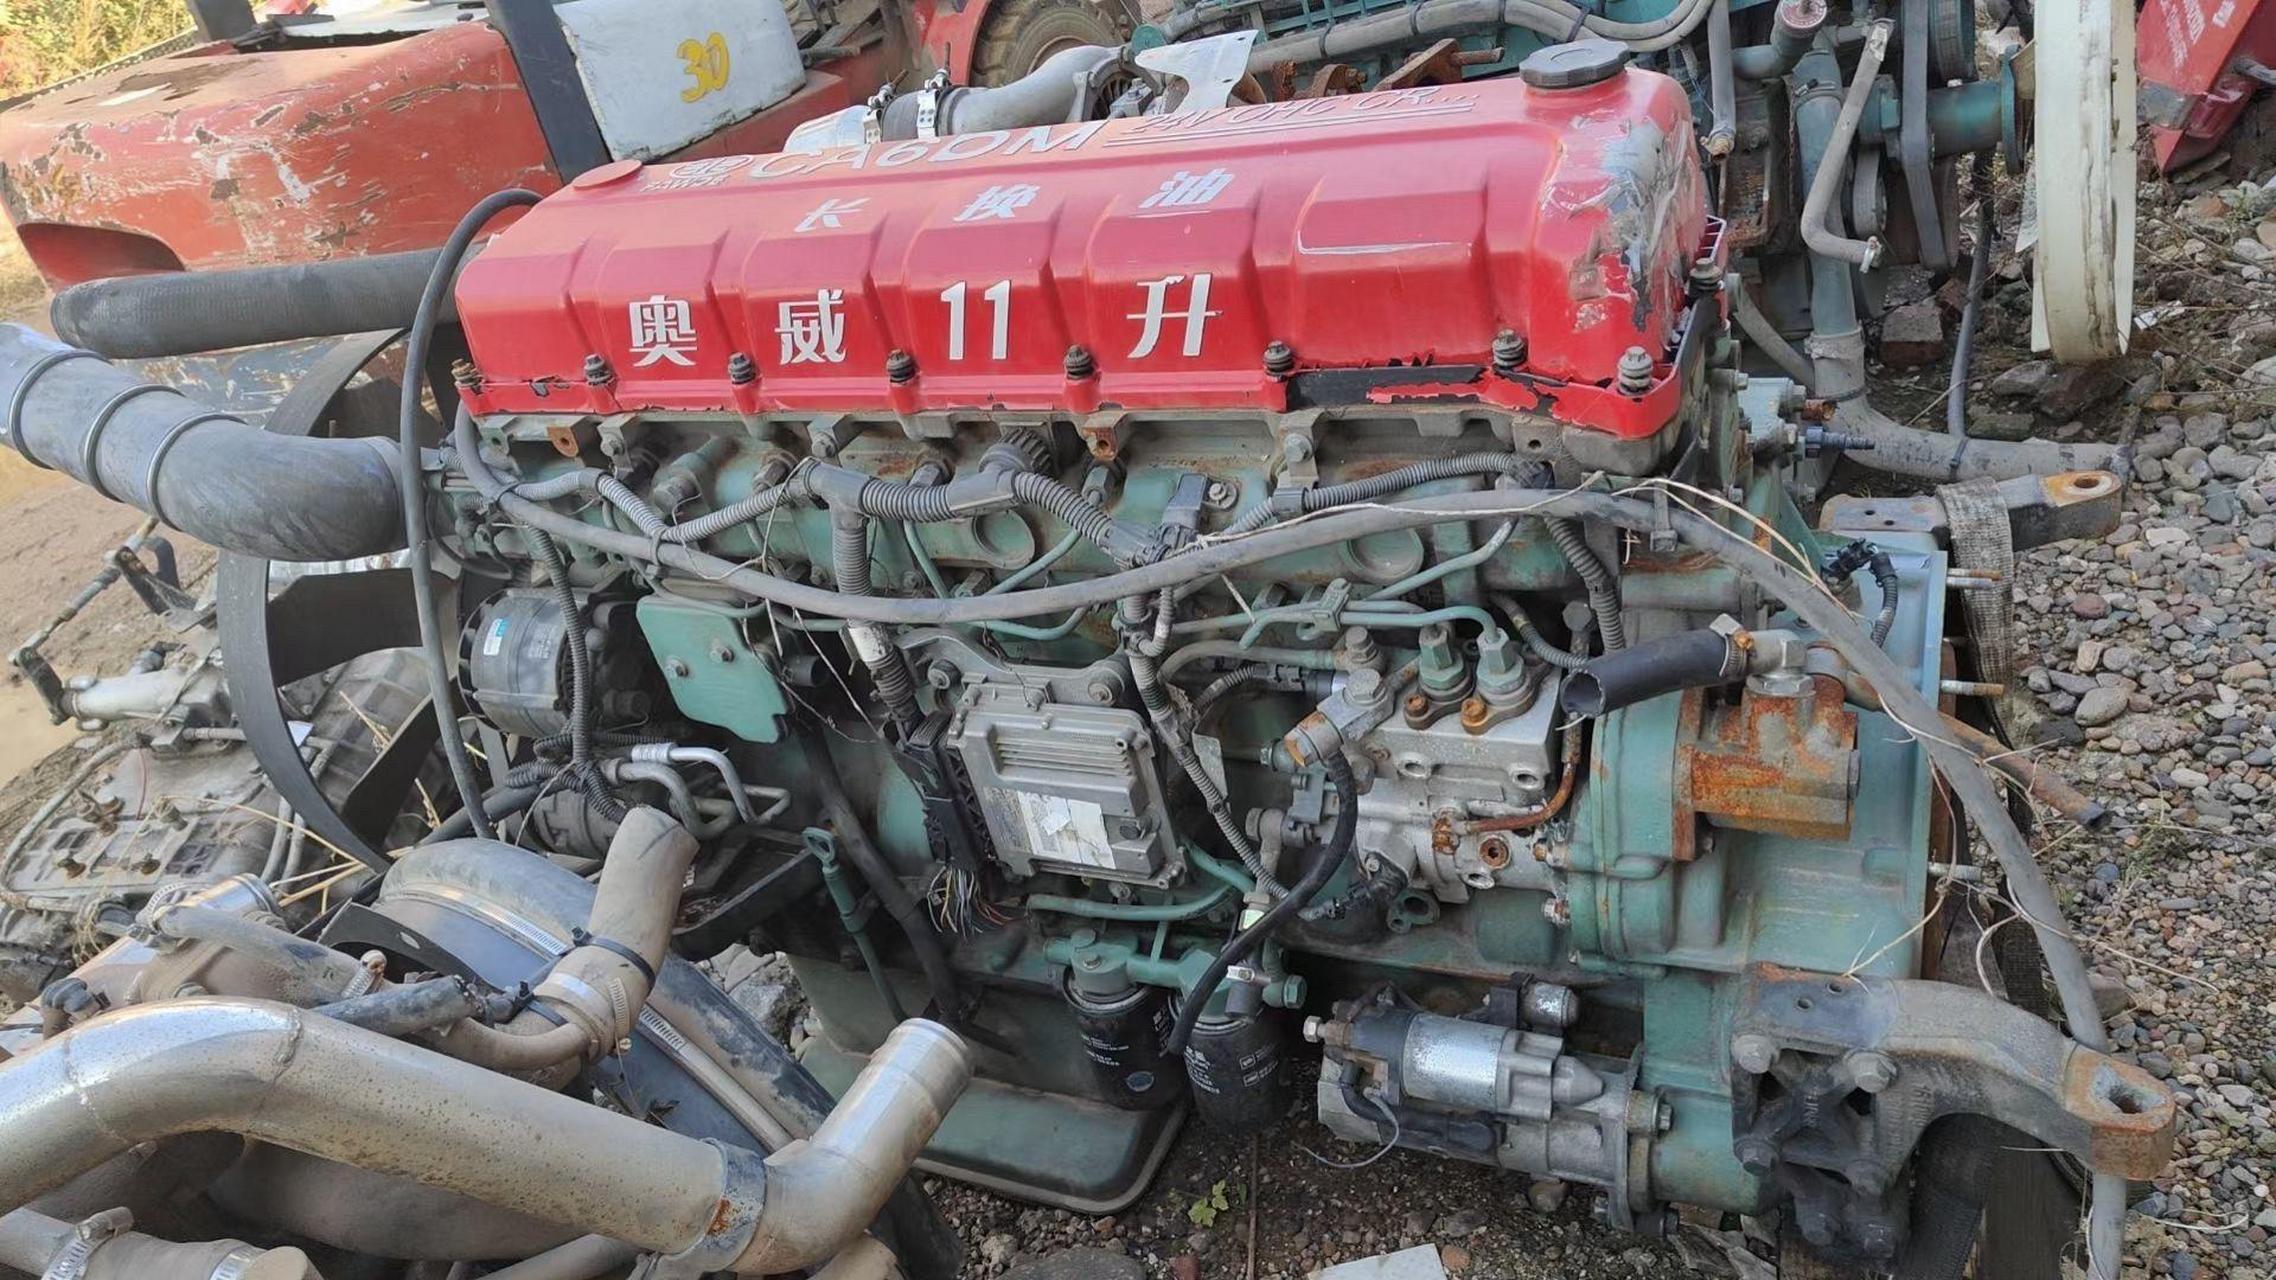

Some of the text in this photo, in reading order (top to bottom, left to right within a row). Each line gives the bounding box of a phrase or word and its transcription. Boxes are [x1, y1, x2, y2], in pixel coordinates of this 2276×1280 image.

[677, 32, 729, 103] 30
[750, 118, 1110, 179] CA6DM
[1227, 96, 1351, 125] OHC
[628, 273, 1224, 368] 奥威11升
